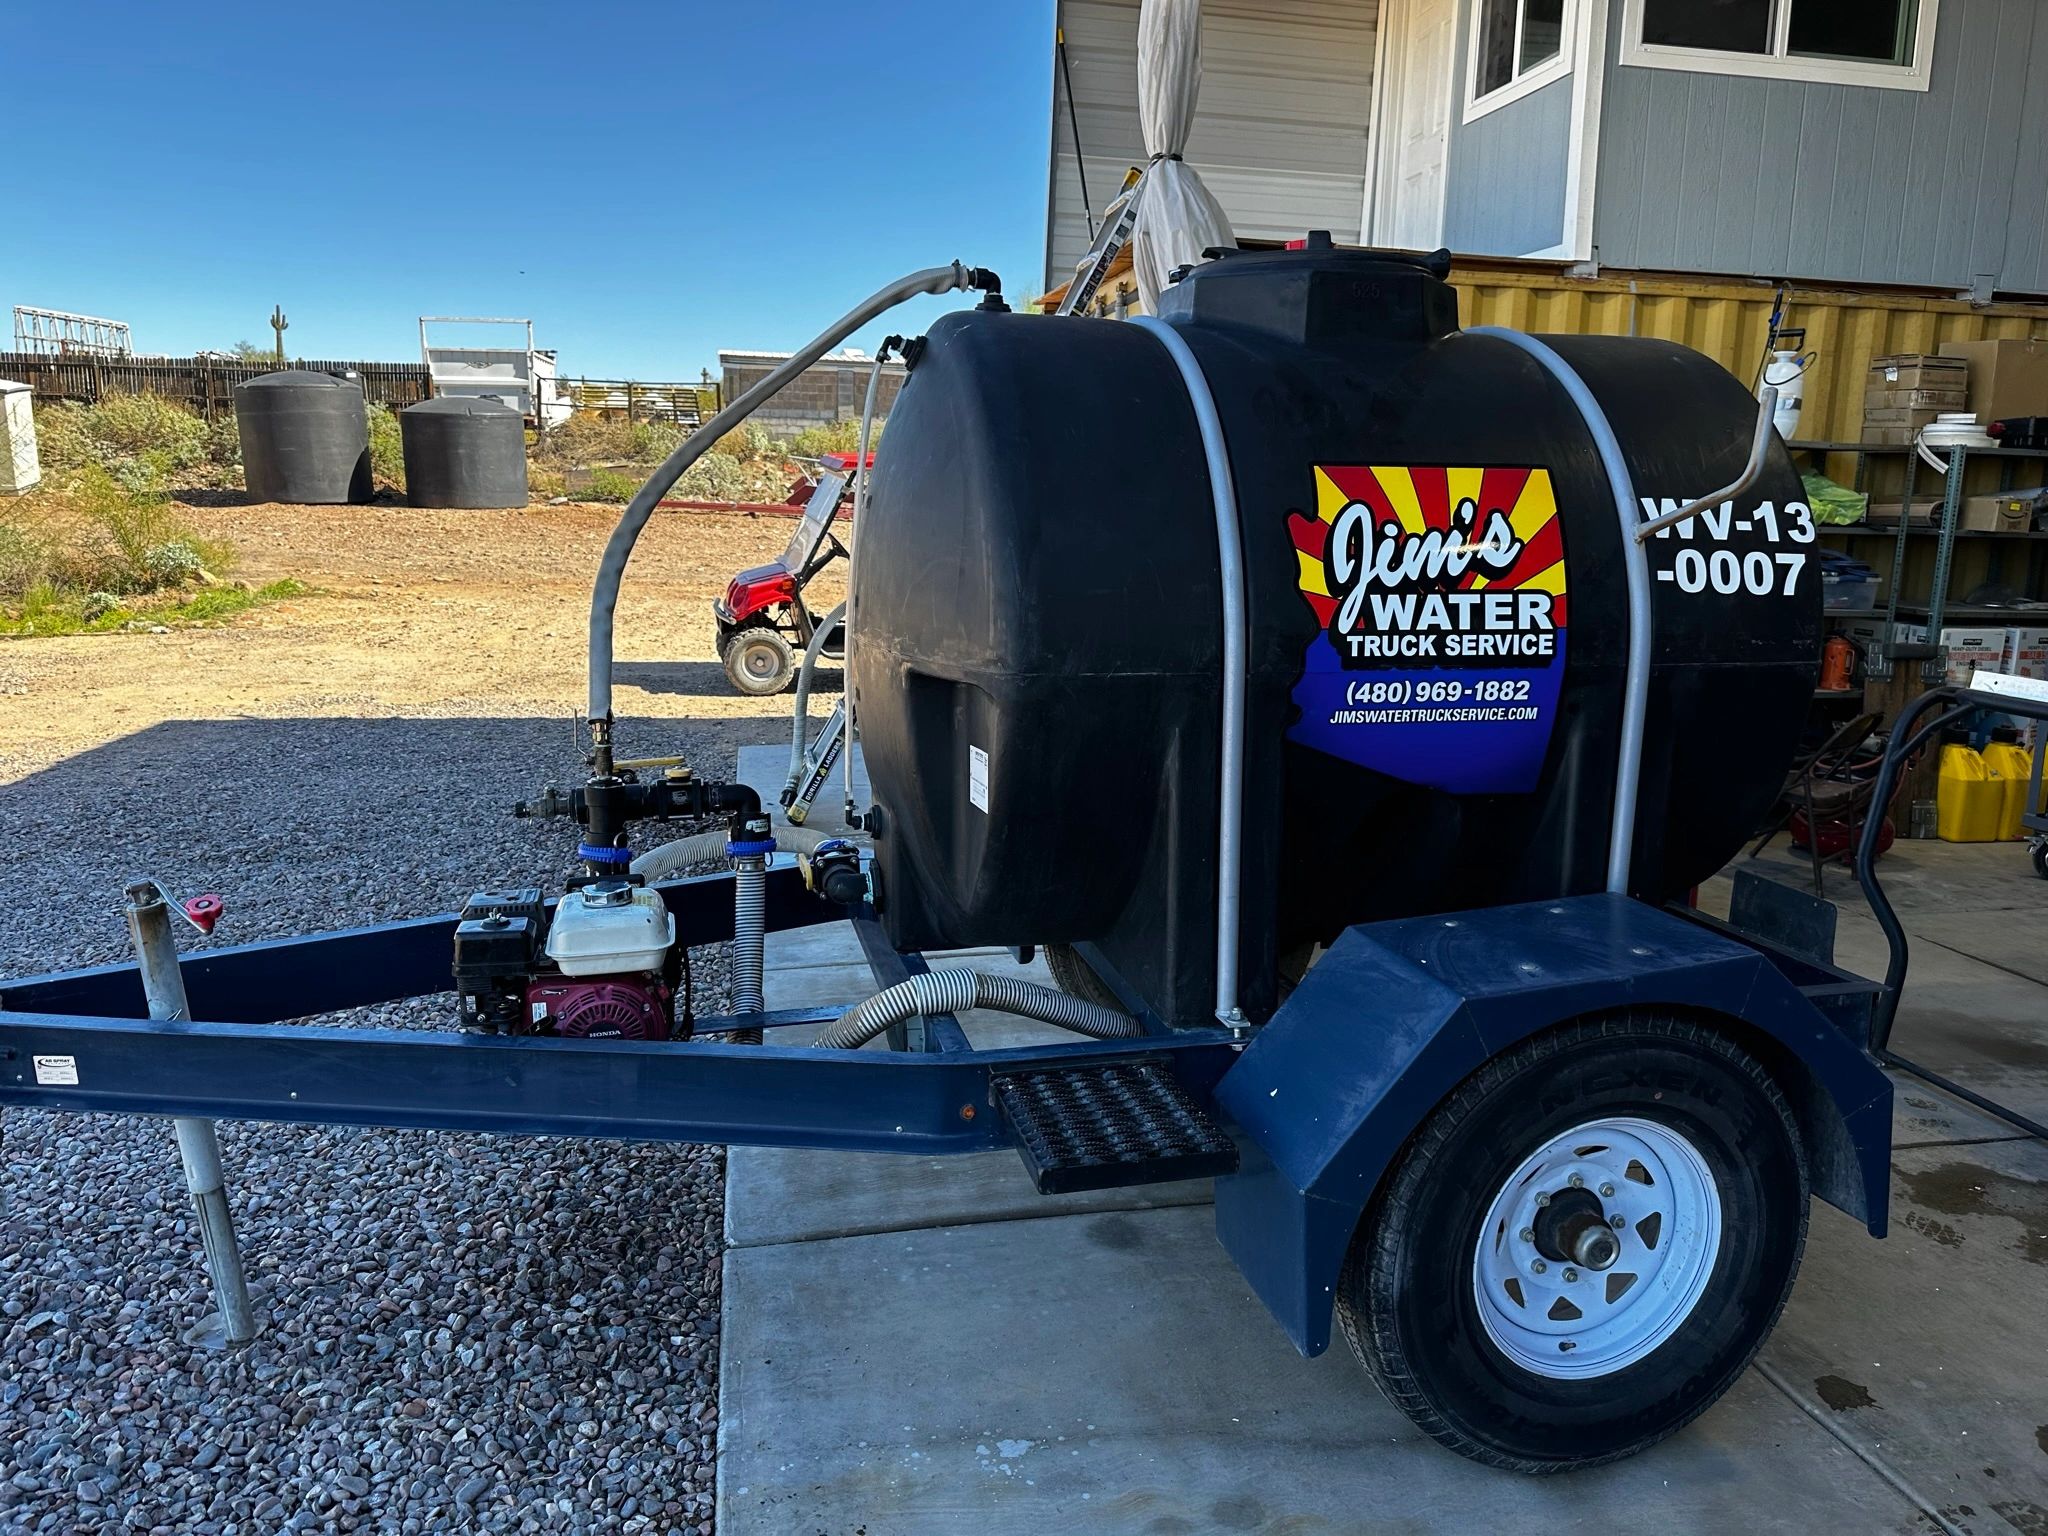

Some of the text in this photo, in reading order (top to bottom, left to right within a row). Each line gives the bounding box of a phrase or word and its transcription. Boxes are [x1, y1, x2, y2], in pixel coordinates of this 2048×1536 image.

[1640, 497, 1816, 544] WV-13
[1332, 502, 1522, 635] Jim's
[1657, 548, 1806, 596] -0007
[1369, 593, 1554, 631] WATER
[1346, 634, 1554, 657] TRUCK SERVICE
[1346, 680, 1530, 706] (480) 969-1882
[1330, 707, 1538, 724] JIMSWATERTRUCKSERVICE.COM
[805, 740, 841, 801] GORILLA LADDERS
[589, 1030, 622, 1038] HONDA
